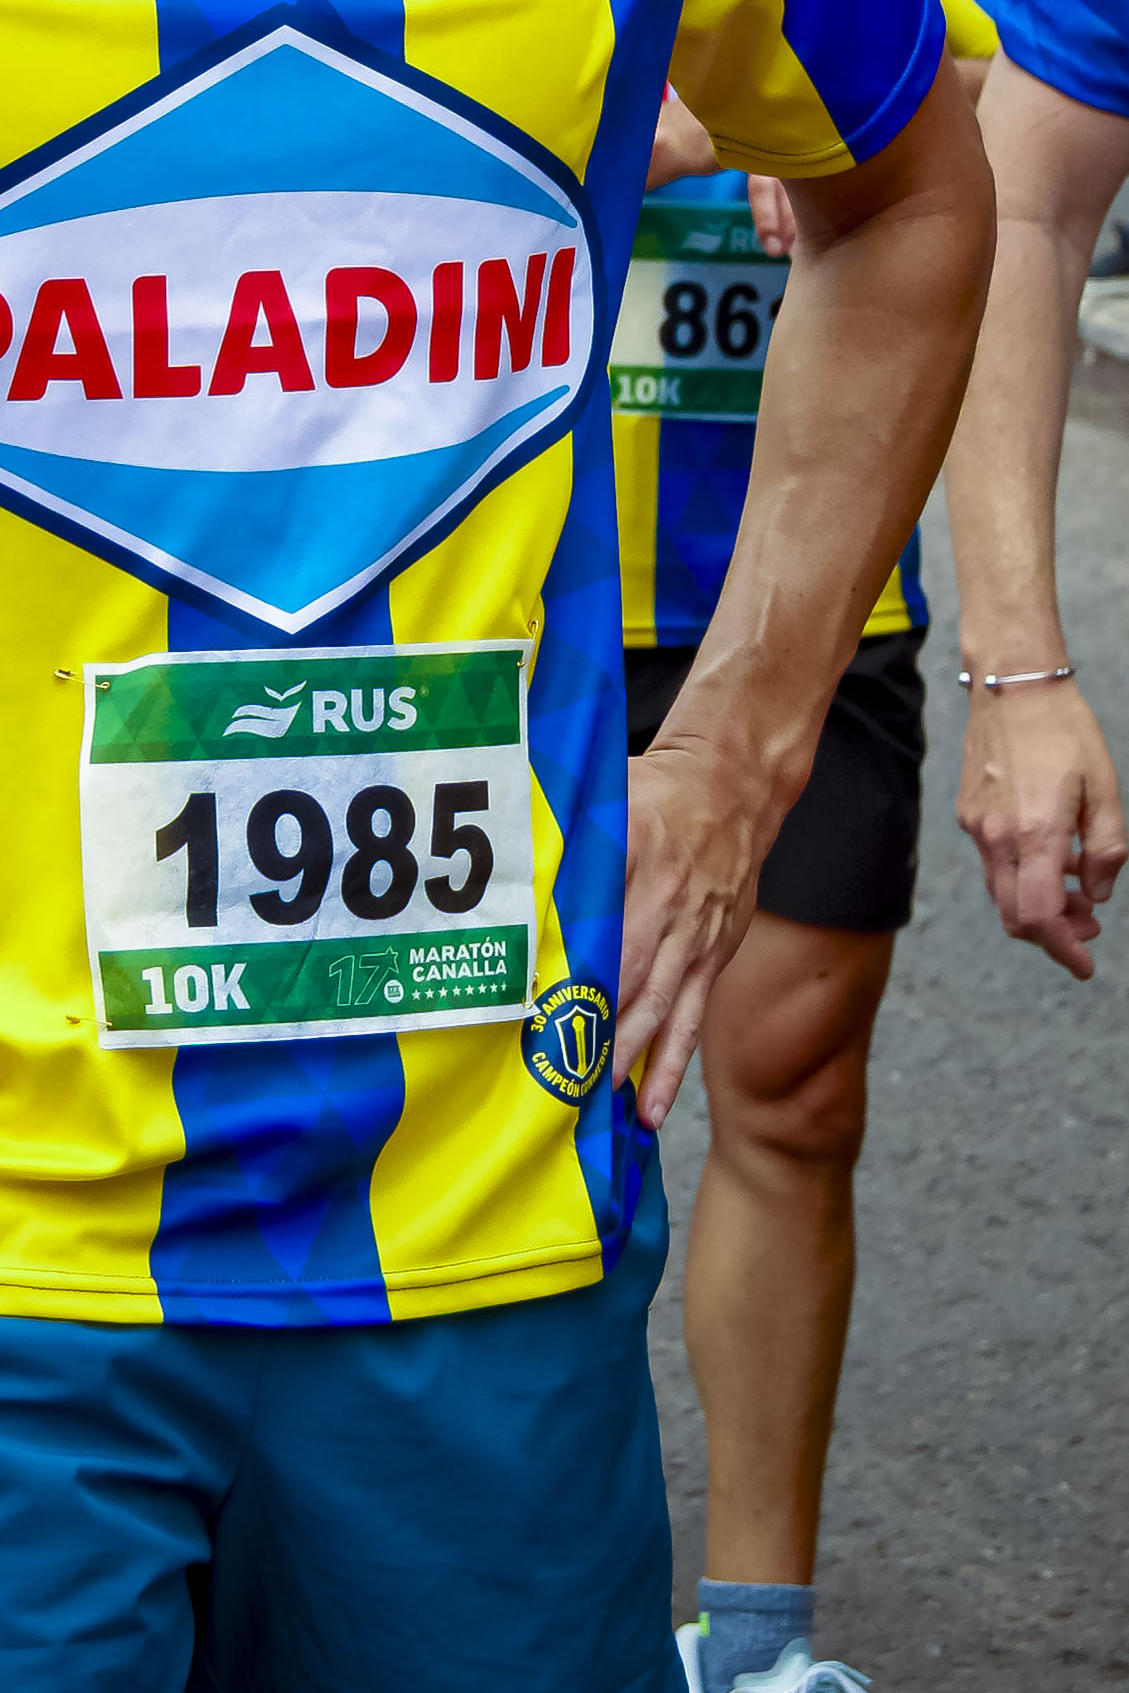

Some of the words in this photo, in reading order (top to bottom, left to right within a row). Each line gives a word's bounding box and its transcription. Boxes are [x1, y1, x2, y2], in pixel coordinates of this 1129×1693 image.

[616, 375, 681, 406] 10K
[312, 686, 418, 733] RUS
[155, 780, 494, 928] 1985
[409, 937, 507, 965] MARATÓN
[412, 959, 508, 982] CANALLA
[142, 963, 251, 1015] 10K
[531, 1014, 548, 1034] 30
[541, 985, 610, 1021] ANIVERSARIO
[531, 1051, 580, 1098] CAMPEÓN
